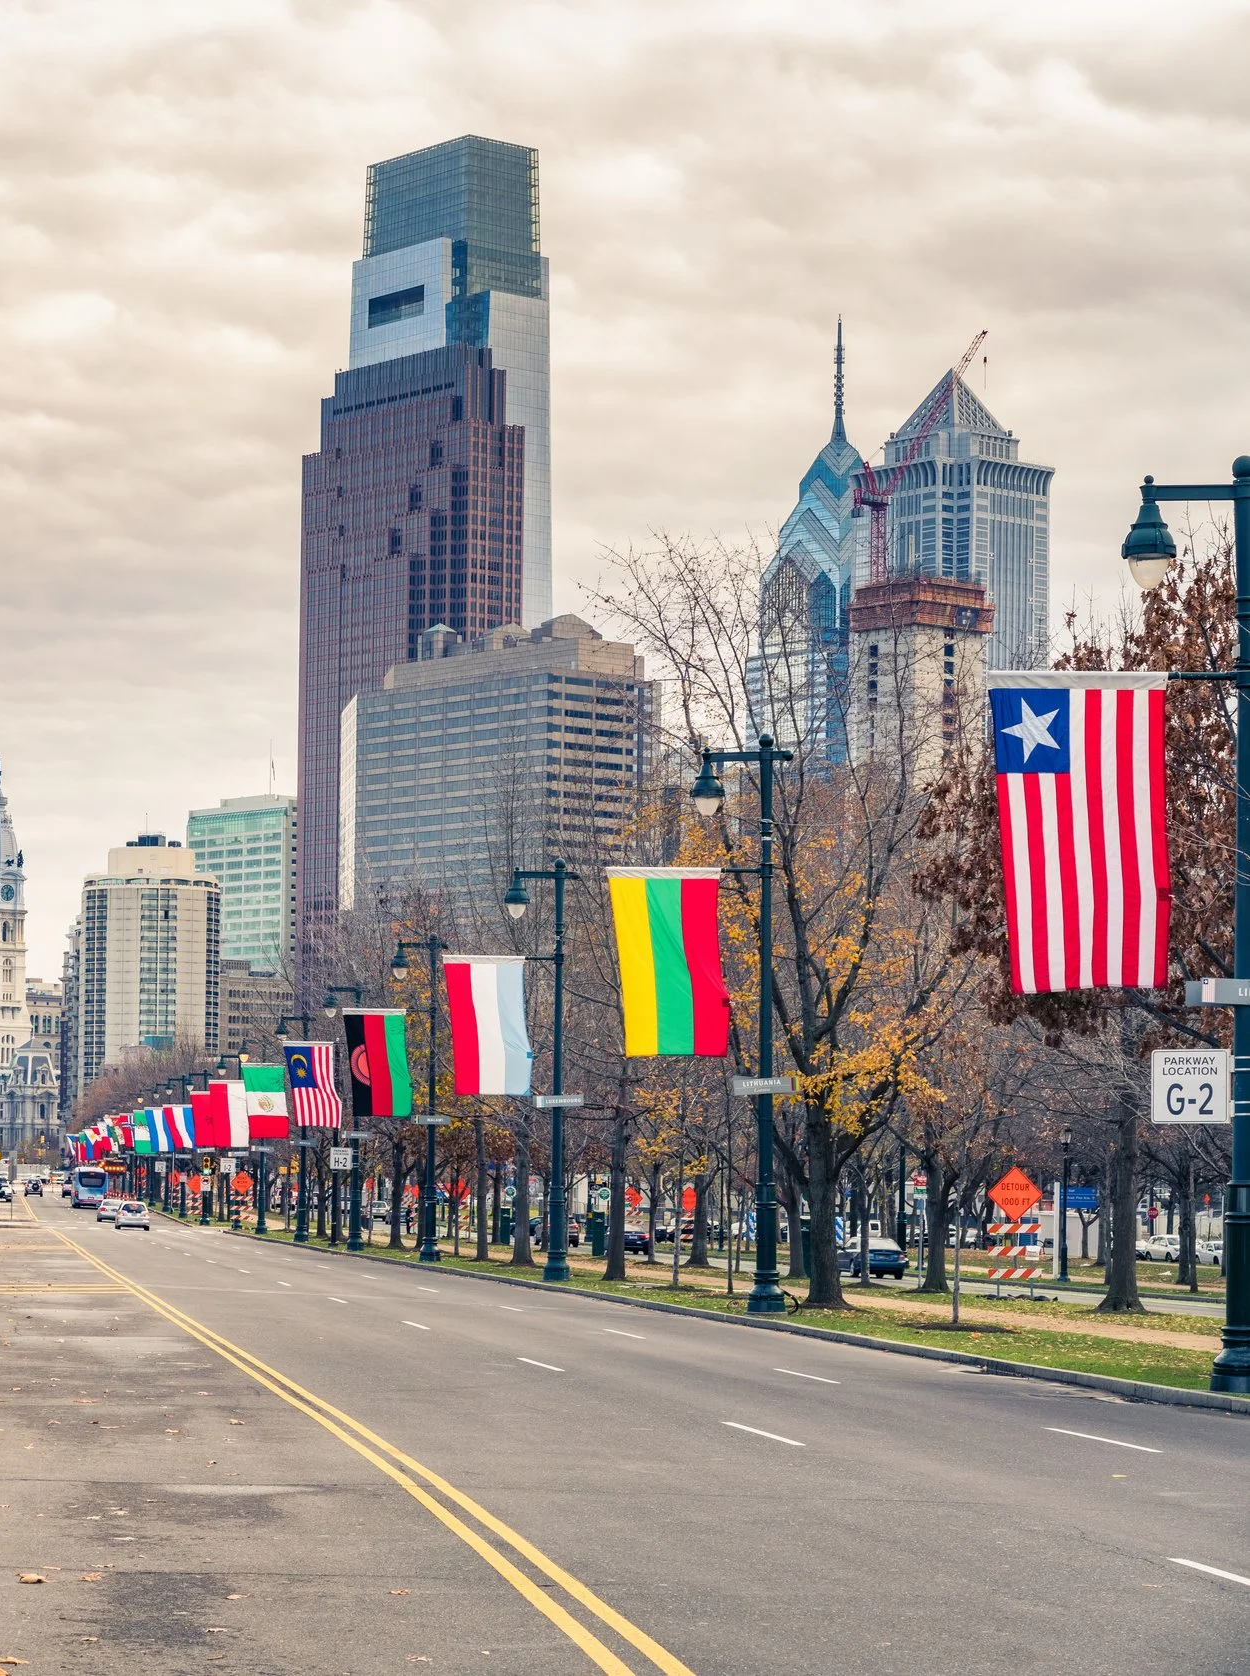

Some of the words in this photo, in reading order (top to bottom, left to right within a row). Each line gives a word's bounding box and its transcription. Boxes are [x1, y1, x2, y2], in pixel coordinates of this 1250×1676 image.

[1239, 987, 1250, 997] LI
[1164, 1056, 1216, 1066] PARKWAY
[1162, 1066, 1218, 1076] LOCATION
[742, 1079, 781, 1088] LITHUANIA
[1166, 1083, 1214, 1116] G-2
[334, 1156, 348, 1168] H-2
[1001, 1182, 1030, 1191] DETOUR
[1001, 1197, 1020, 1206] 1000
[1022, 1198, 1030, 1206] FT
